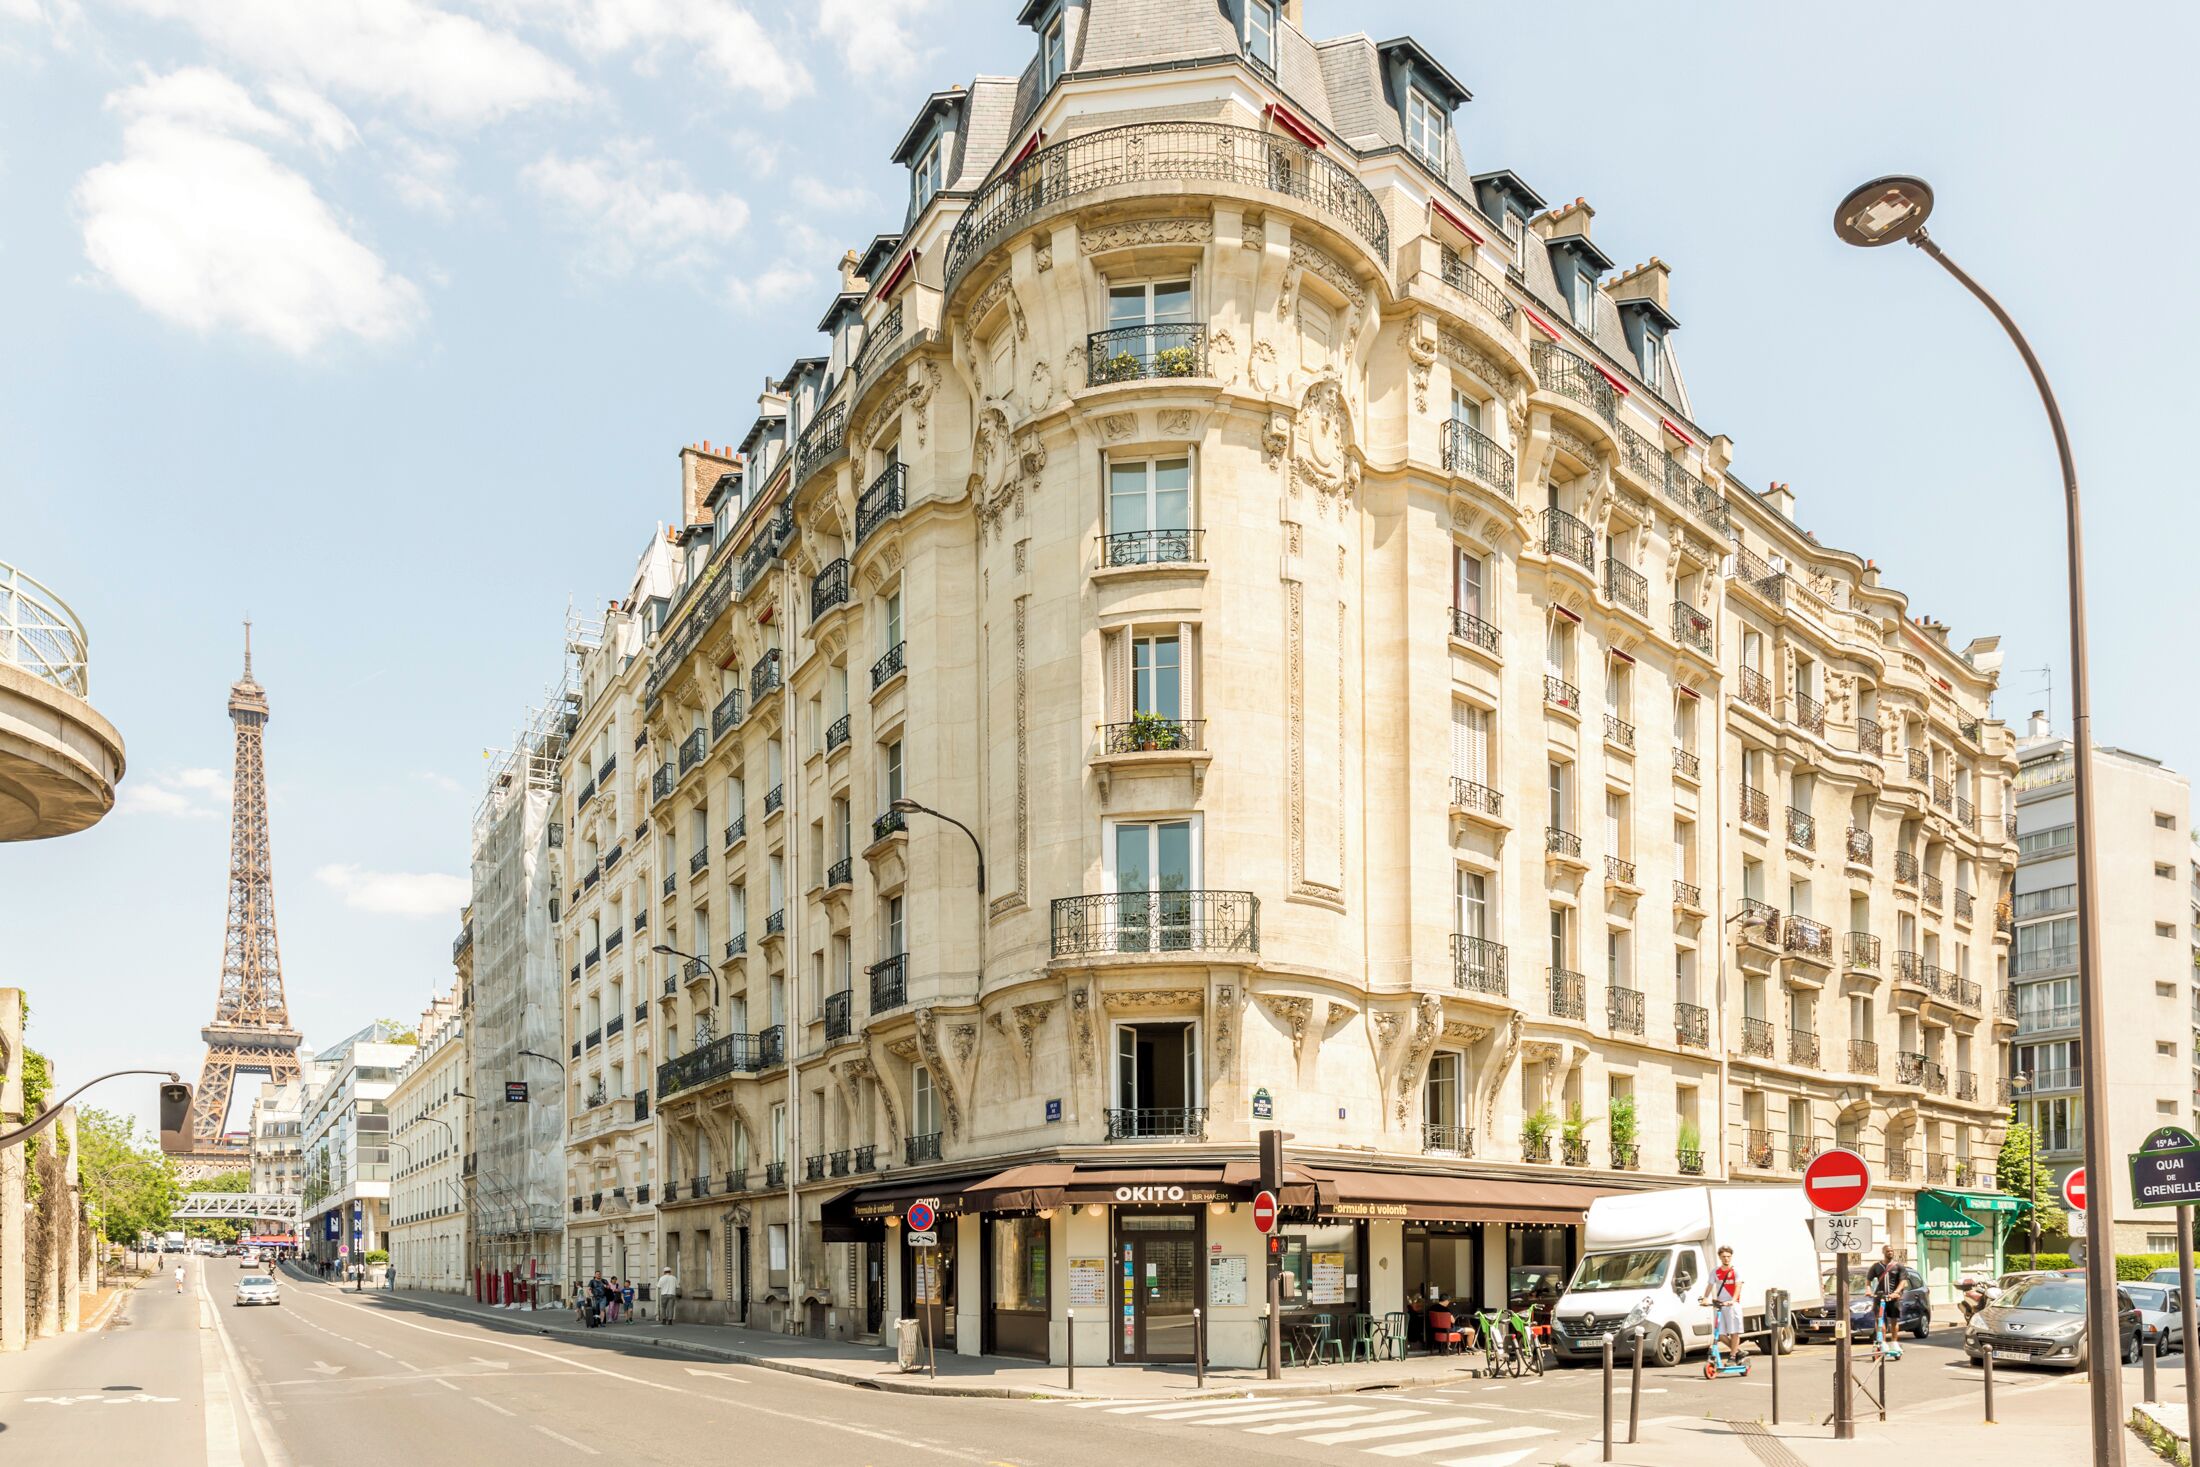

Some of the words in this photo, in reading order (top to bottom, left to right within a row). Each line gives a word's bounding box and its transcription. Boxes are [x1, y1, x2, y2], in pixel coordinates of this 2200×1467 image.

[2156, 1158, 2184, 1171] QUAI
[1115, 1186, 1184, 1201] OKITO
[2143, 1181, 2200, 1196] GRENELLE
[1333, 1203, 1368, 1214] Formule
[1369, 1203, 1376, 1214] à
[1377, 1204, 1408, 1215] volonté
[1828, 1219, 1860, 1228] SAUF
